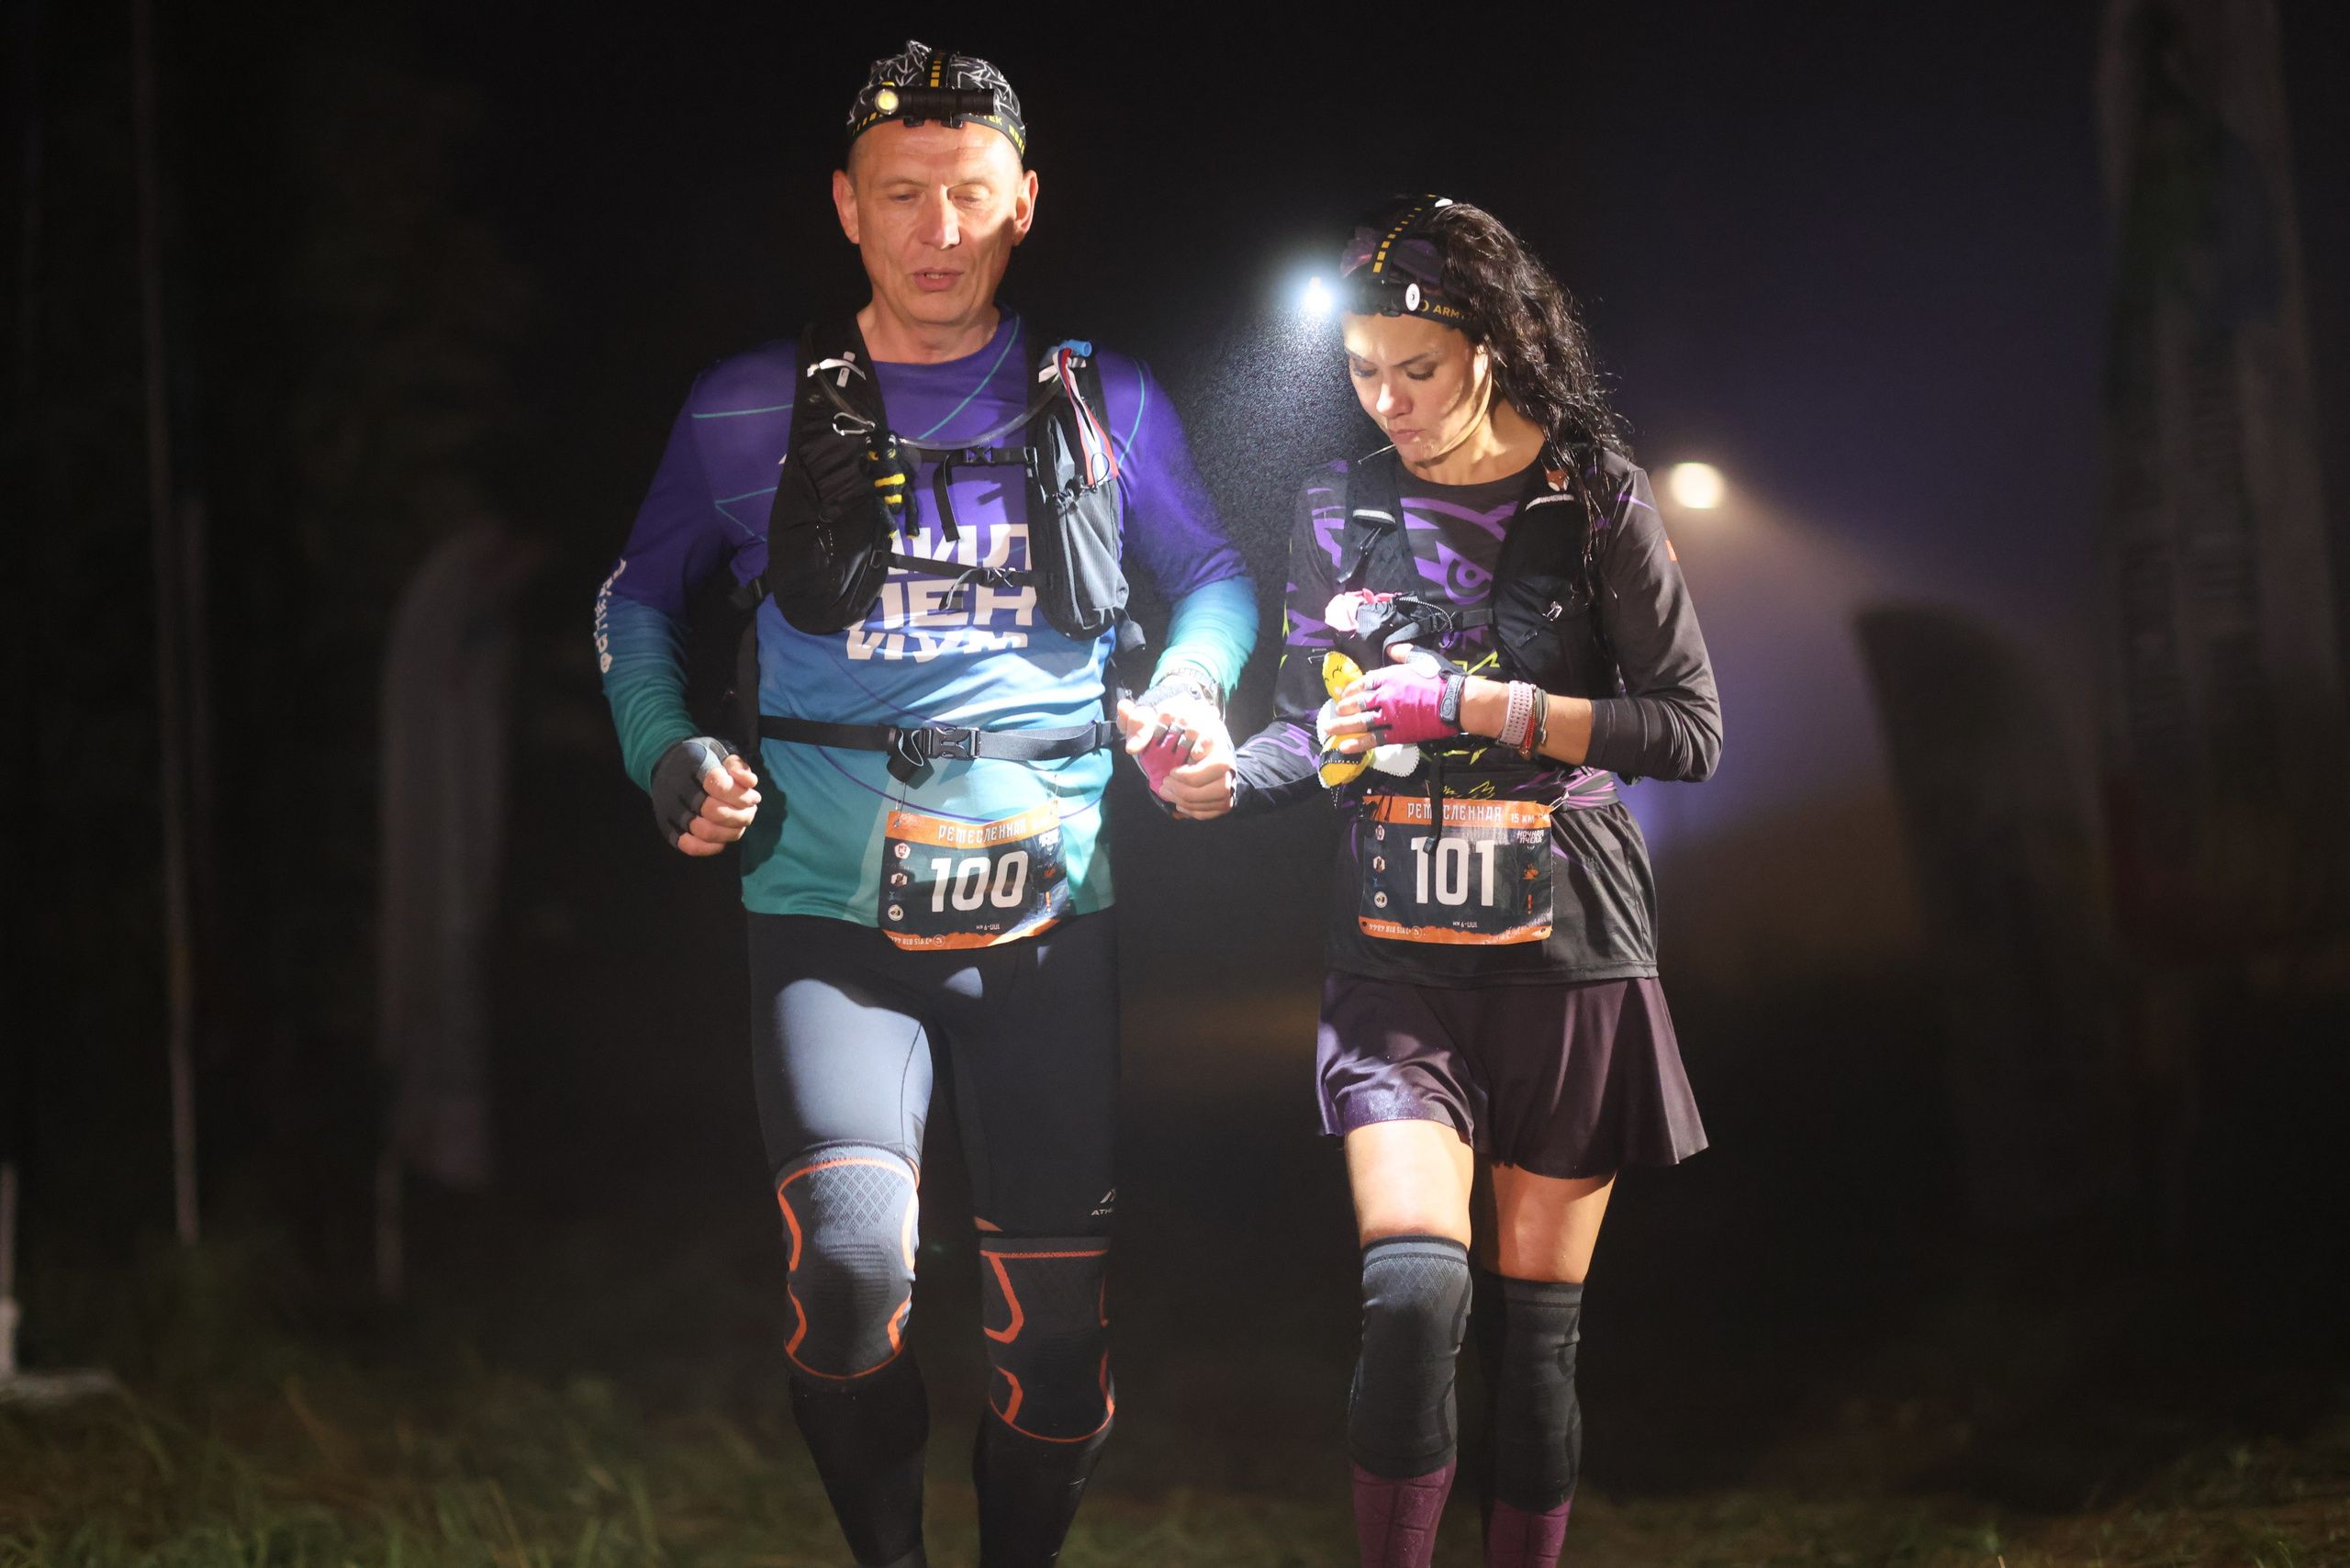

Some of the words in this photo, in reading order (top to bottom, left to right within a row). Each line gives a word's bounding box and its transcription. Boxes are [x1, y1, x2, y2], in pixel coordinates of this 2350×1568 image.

[1407, 802, 1502, 822] РЕМСЛЕННАЯ
[1511, 813, 1520, 823] 15
[1516, 830, 1544, 839] НОЧНАЯ
[931, 851, 1028, 913] 100
[1411, 837, 1496, 907] 101
